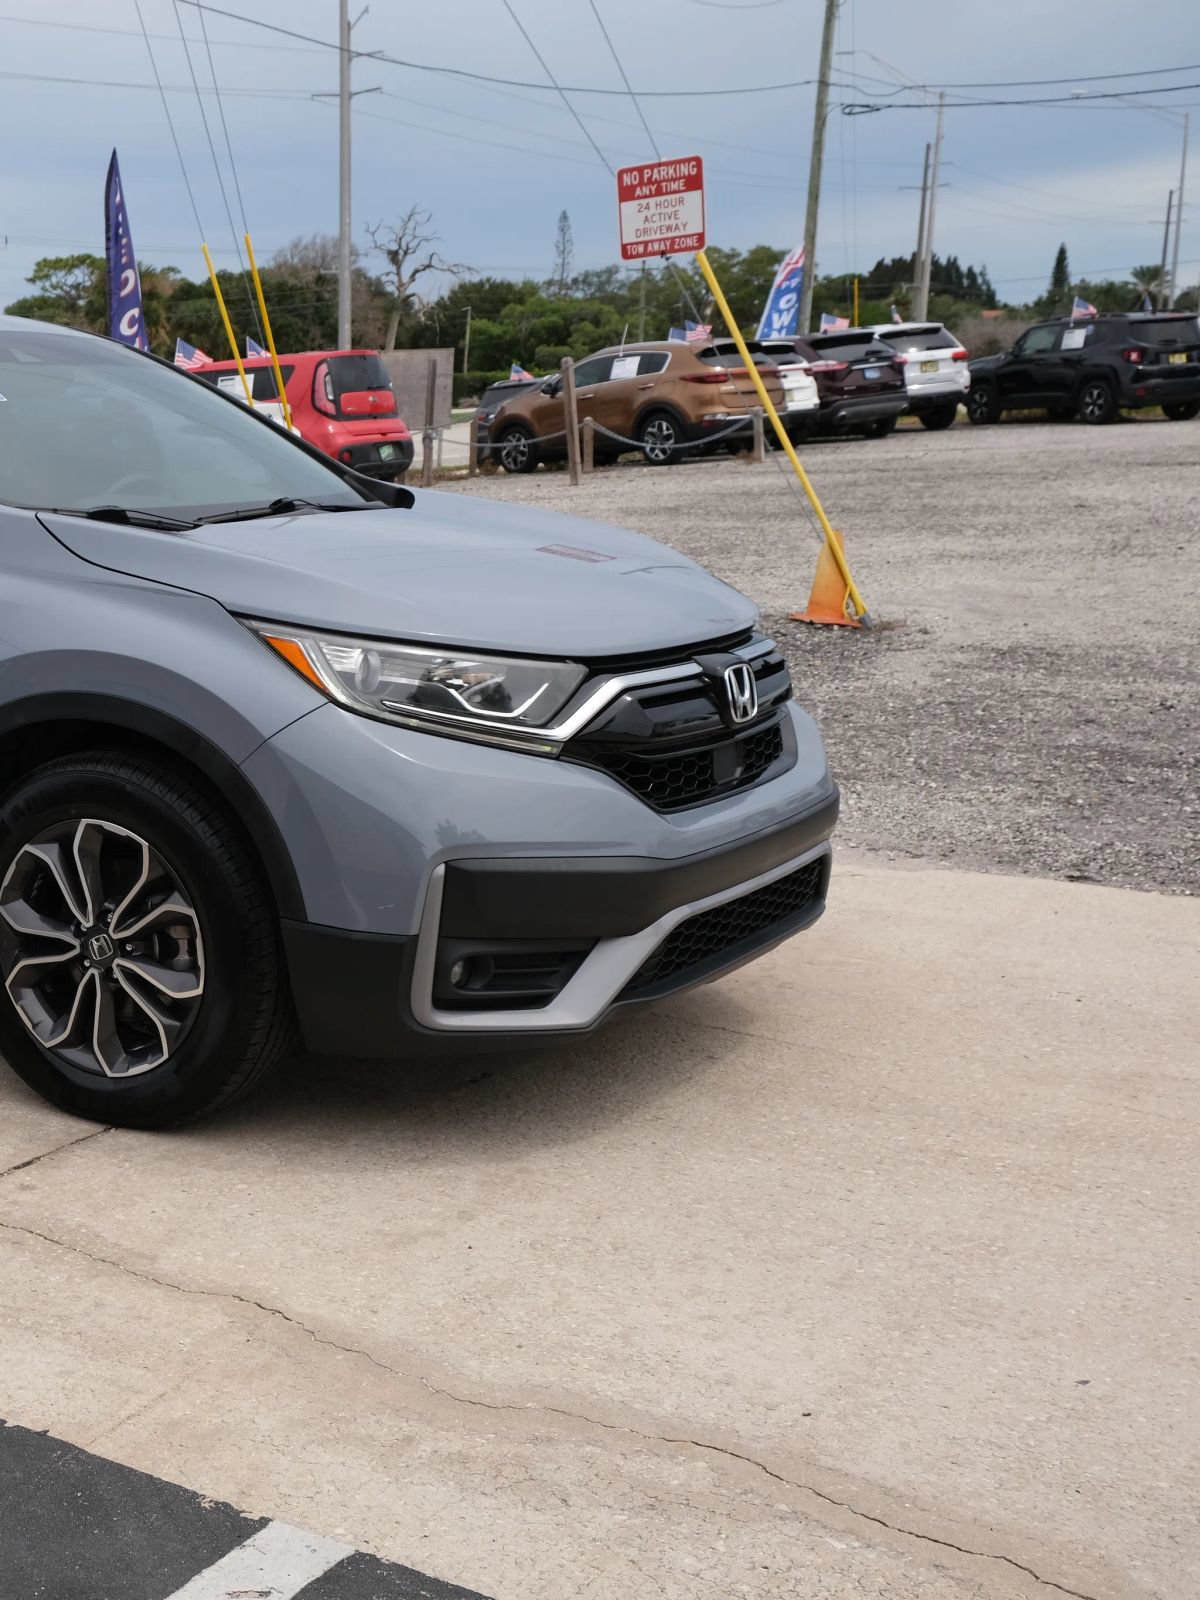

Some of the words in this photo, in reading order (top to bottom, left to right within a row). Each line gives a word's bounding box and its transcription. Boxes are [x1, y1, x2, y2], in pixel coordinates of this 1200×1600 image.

[623, 171, 639, 186] NO
[643, 161, 697, 183] PARKING
[635, 184, 657, 198] ANY
[661, 179, 687, 193] TIME
[637, 202, 650, 213] 24
[655, 197, 685, 210] HOUR
[643, 210, 681, 224] ACTIVE
[635, 221, 688, 238] DRIVEWAY
[626, 244, 645, 256] TOW
[647, 239, 672, 253] AWAY
[674, 235, 699, 249] ZONE
